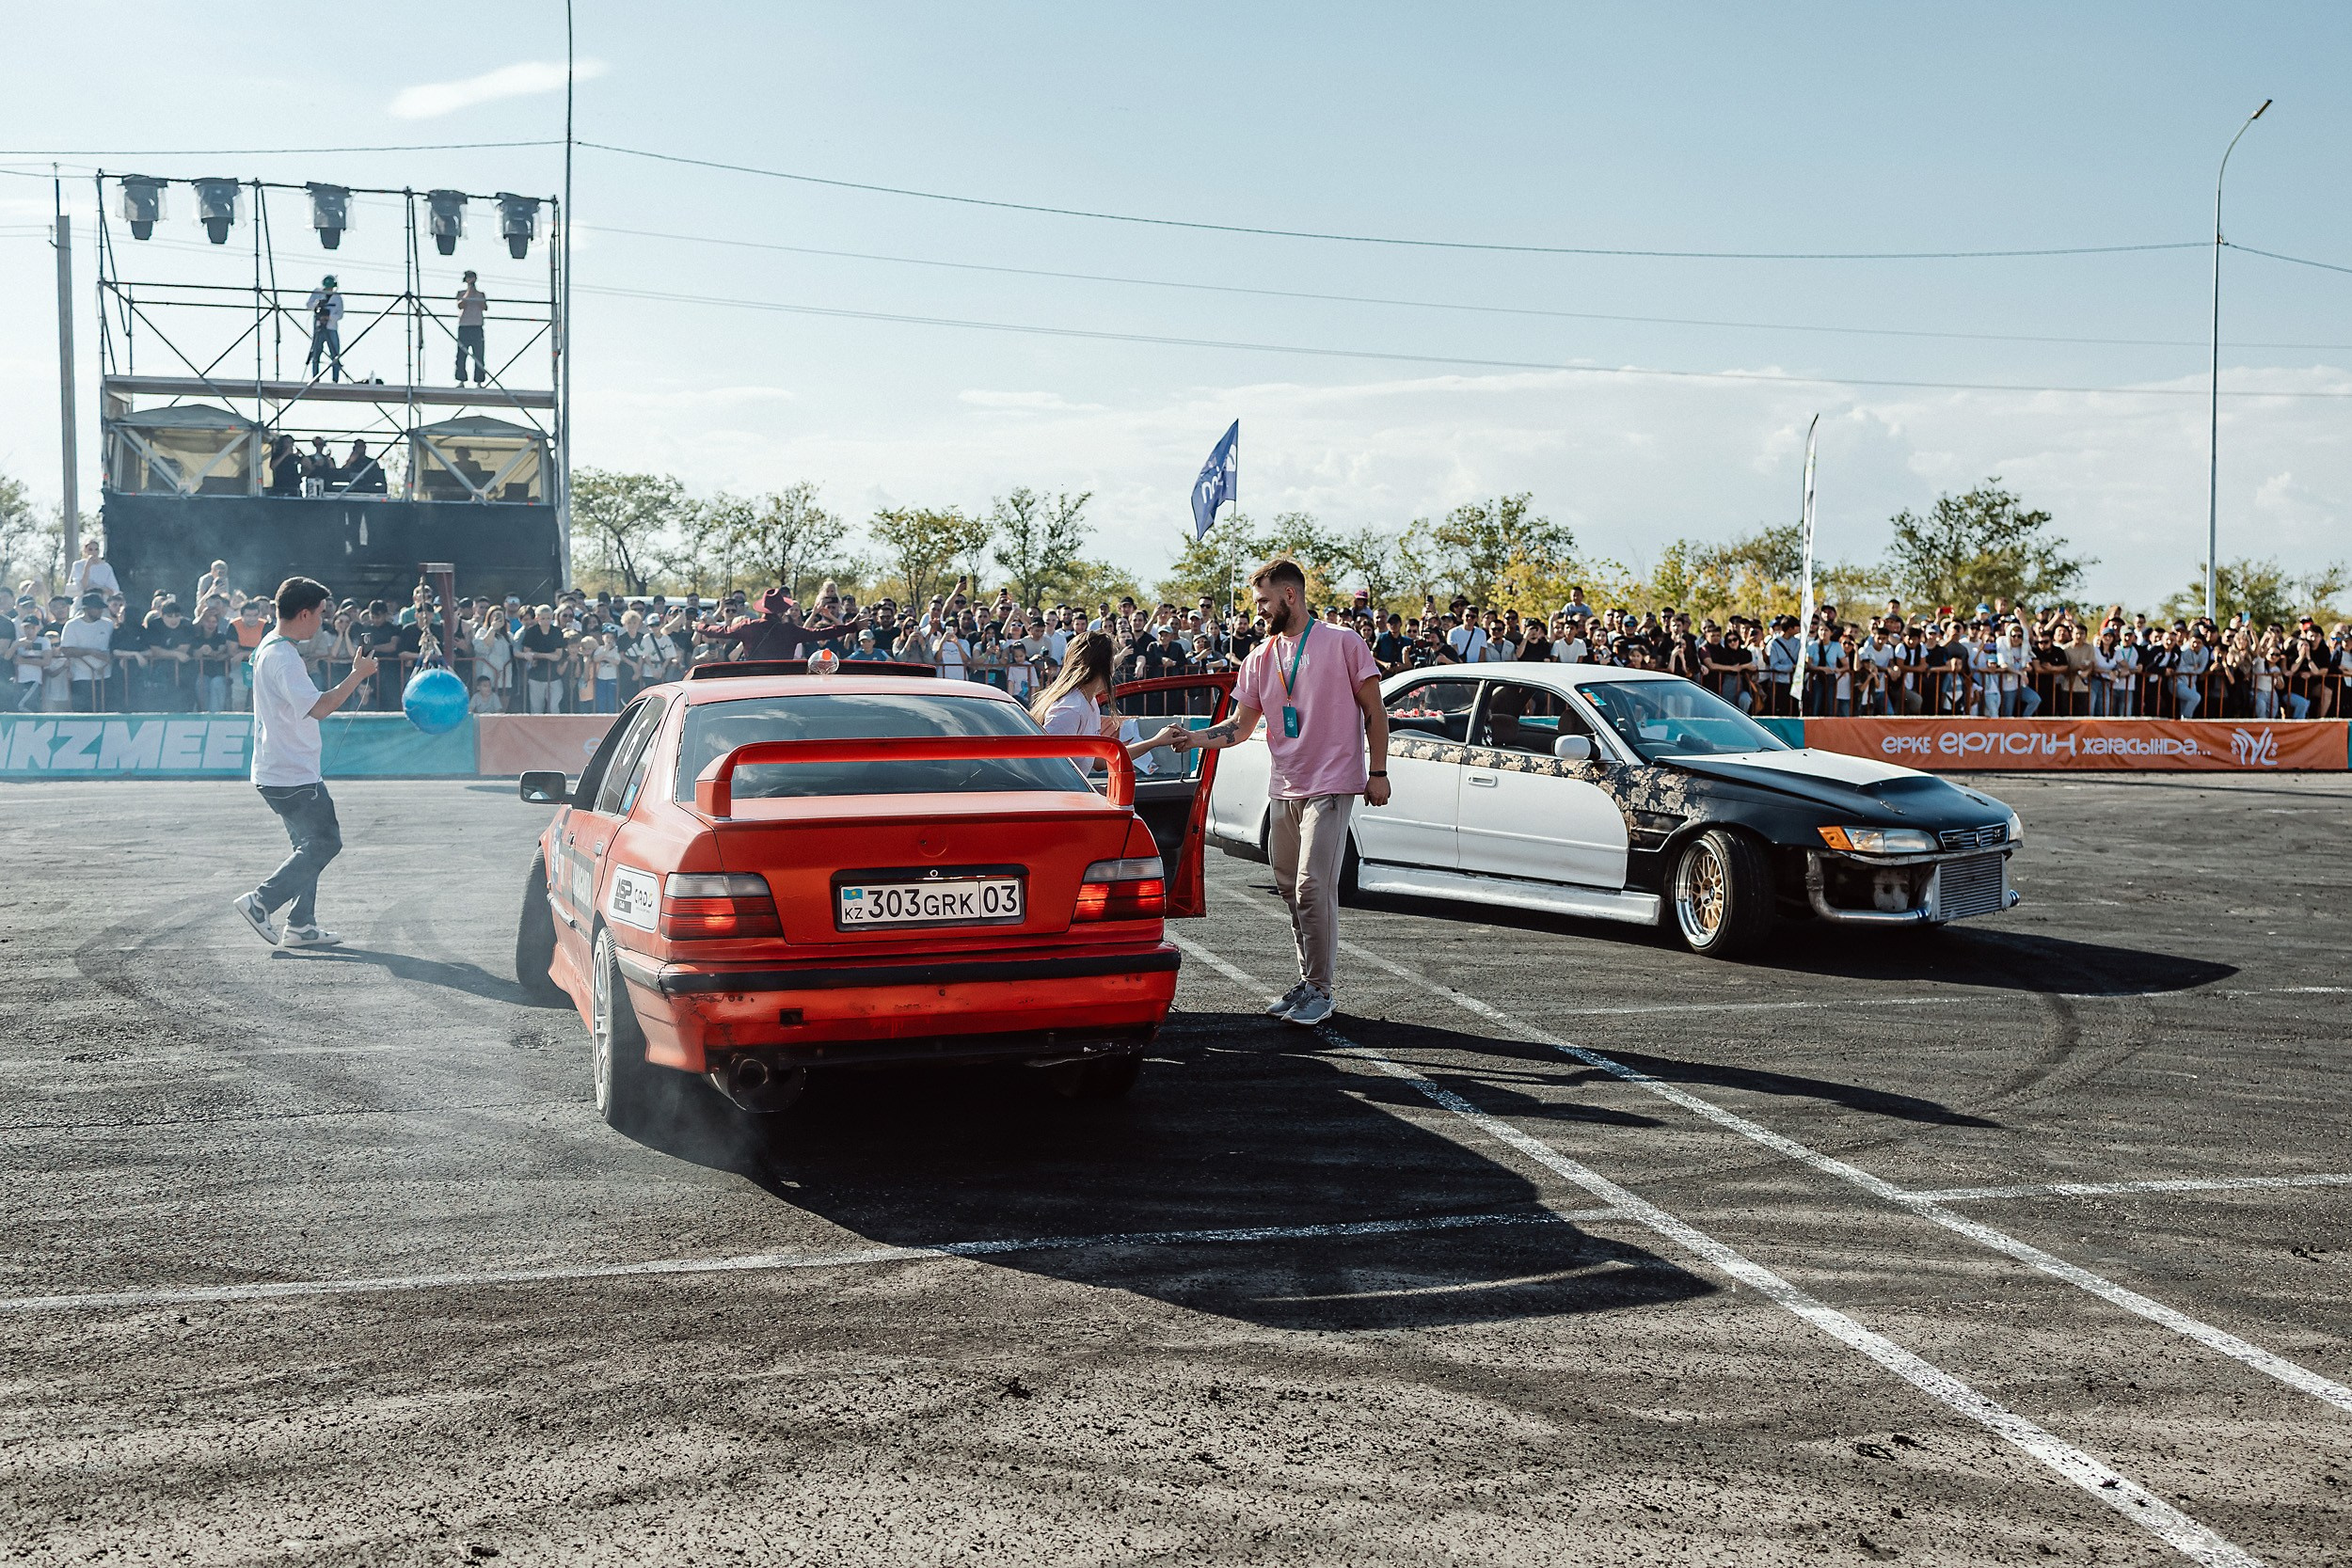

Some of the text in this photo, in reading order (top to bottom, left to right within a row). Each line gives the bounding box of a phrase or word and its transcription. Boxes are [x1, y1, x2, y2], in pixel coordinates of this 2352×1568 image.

[0, 721, 254, 769] KZMEE
[845, 908, 864, 920] KZ
[983, 884, 1017, 914] 03
